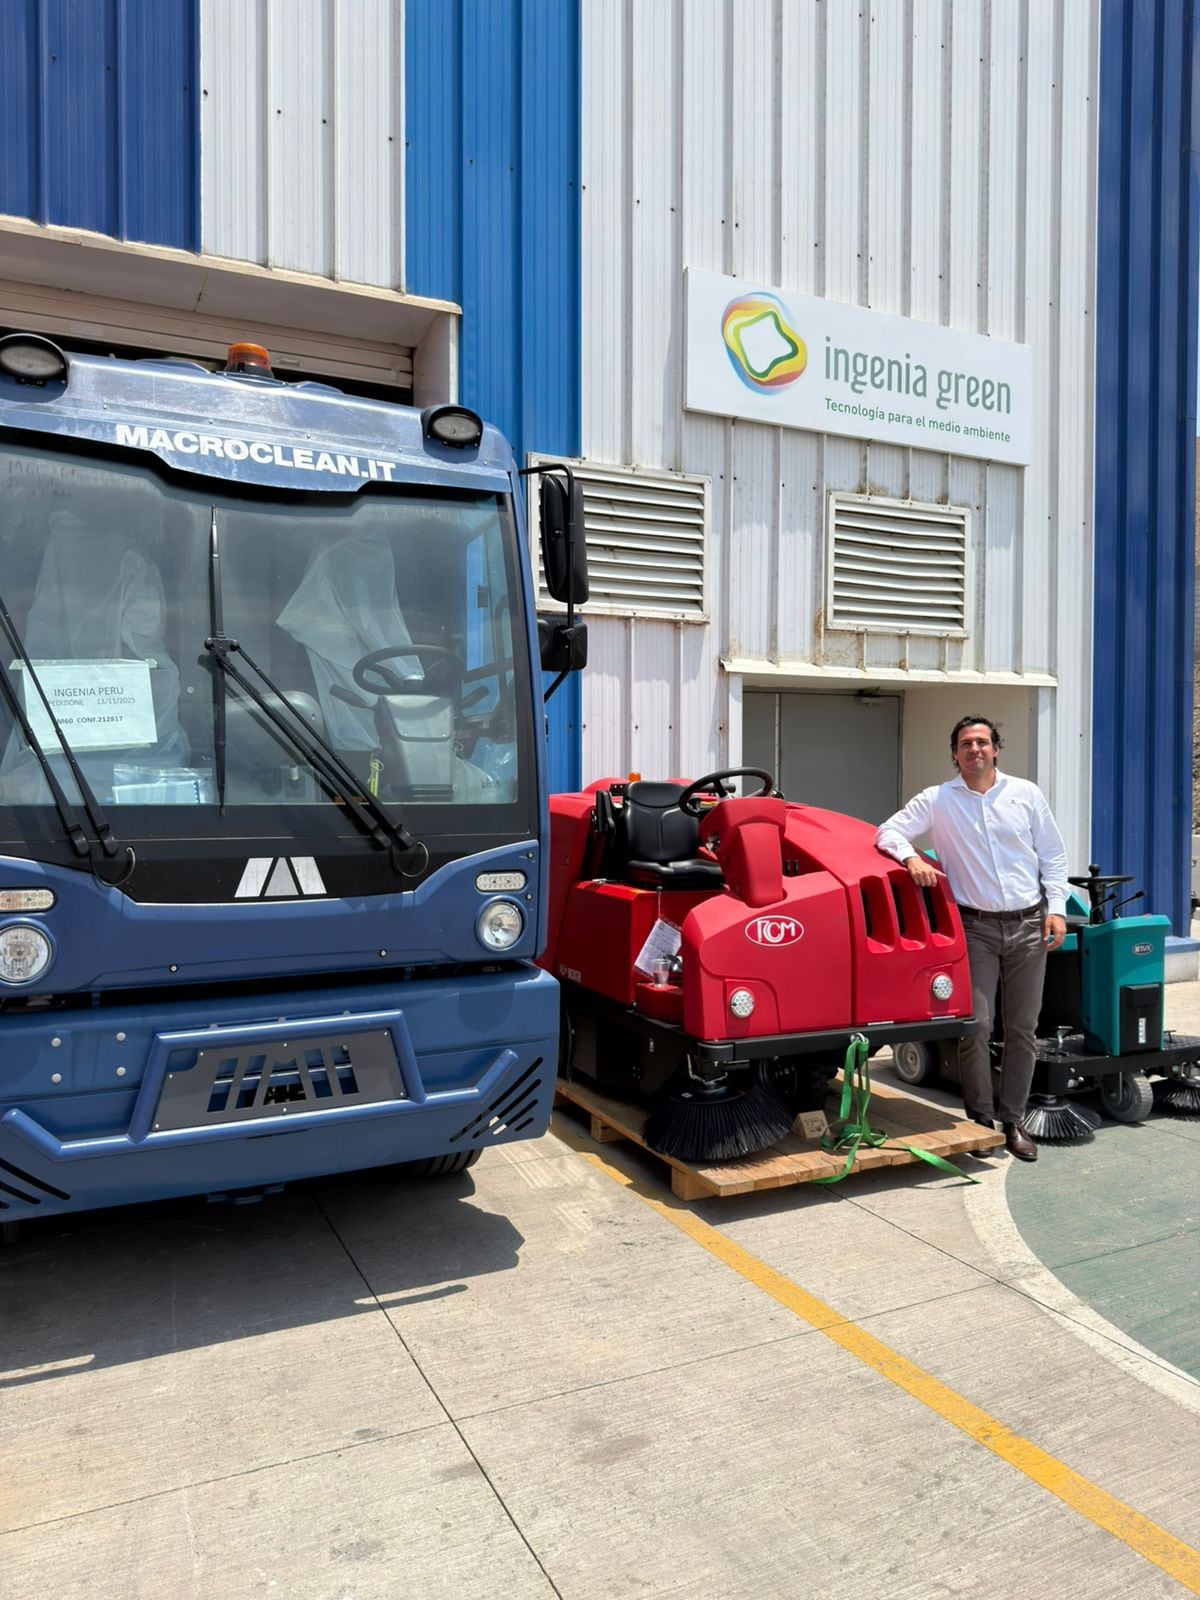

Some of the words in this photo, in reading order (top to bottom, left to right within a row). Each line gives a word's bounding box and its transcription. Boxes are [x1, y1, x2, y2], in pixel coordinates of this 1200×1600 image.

[825, 336, 928, 398] ingenia
[935, 370, 1011, 415] green
[825, 398, 885, 421] Tecnología
[888, 412, 913, 425] para
[915, 416, 926, 428] el
[929, 418, 961, 434] medio
[963, 424, 1011, 443] ambiente
[115, 423, 397, 481] MACROCLEAN.IT
[49, 699, 84, 707] PEDIZIONE
[97, 697, 136, 705] 13/11/2025
[54, 687, 96, 697] INGENIA
[98, 686, 124, 695] PERU
